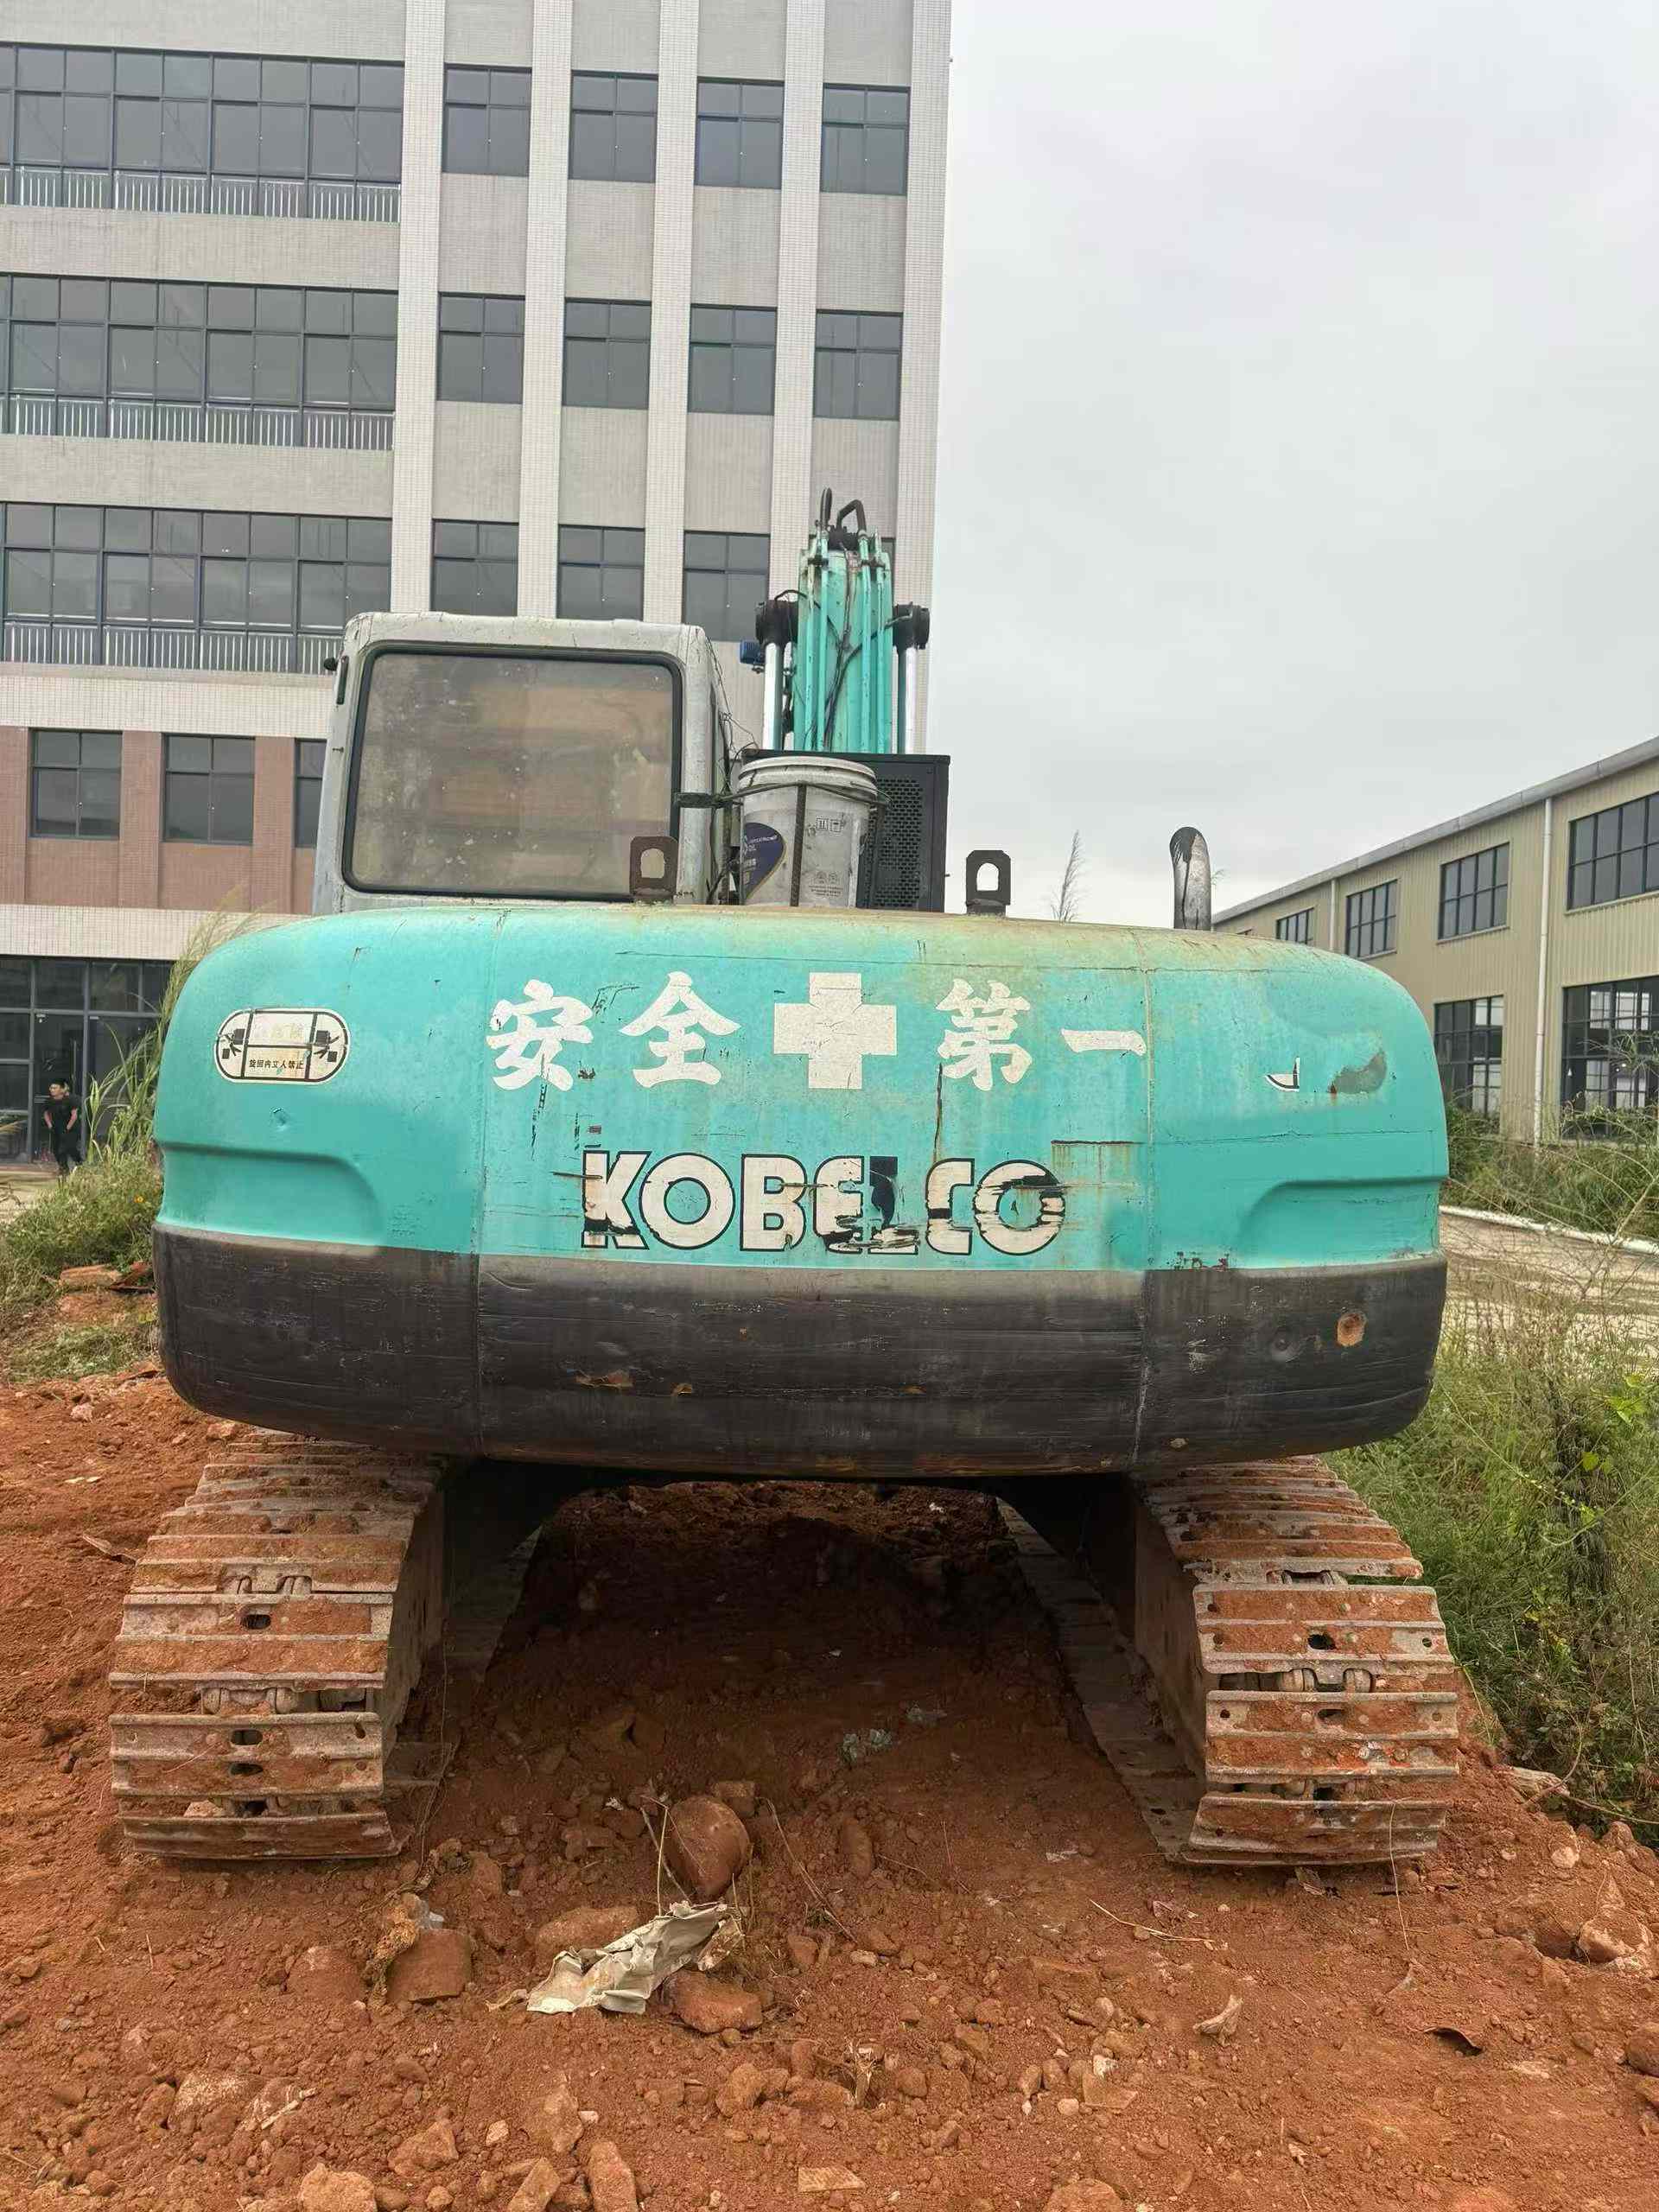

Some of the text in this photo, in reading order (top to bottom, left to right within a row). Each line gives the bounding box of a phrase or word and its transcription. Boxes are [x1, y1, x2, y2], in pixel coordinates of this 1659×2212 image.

[486, 971, 1147, 1091] 安全 第一
[582, 1148, 1067, 1256] KOBELCO
